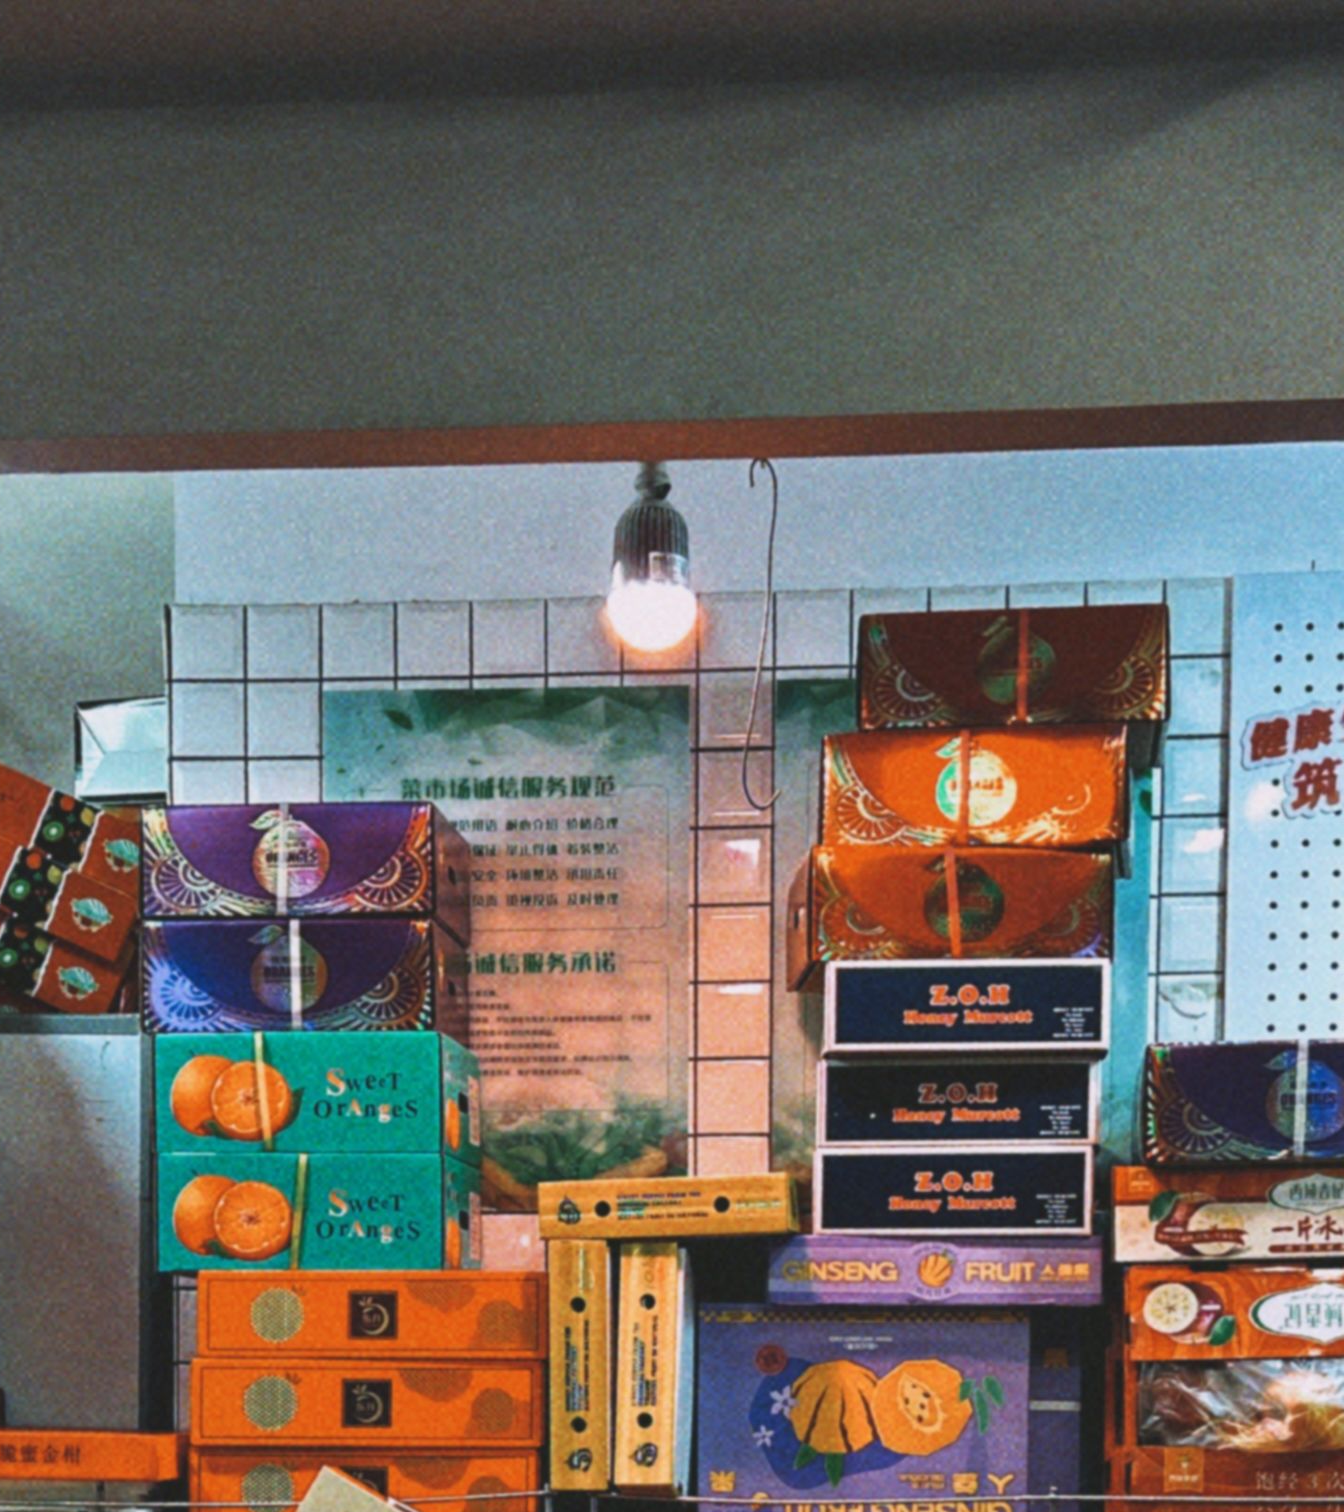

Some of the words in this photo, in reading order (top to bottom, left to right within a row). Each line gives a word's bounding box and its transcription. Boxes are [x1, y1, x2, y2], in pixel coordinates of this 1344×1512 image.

[401, 776, 616, 800] 菜市场诚信服务规范
[929, 983, 1010, 1007] Z.O.H
[902, 1009, 958, 1027] Honey
[963, 1009, 1034, 1025] Murcott
[918, 1082, 998, 1105] Z.O.H
[892, 1107, 946, 1124] Honey
[951, 1107, 1022, 1122] Murcott
[914, 1170, 994, 1192] Z.O.H
[888, 1196, 942, 1213] Honey
[947, 1195, 1017, 1211] Murcott
[782, 1260, 899, 1283] GINSENG
[964, 1259, 1036, 1283] FRUIT
